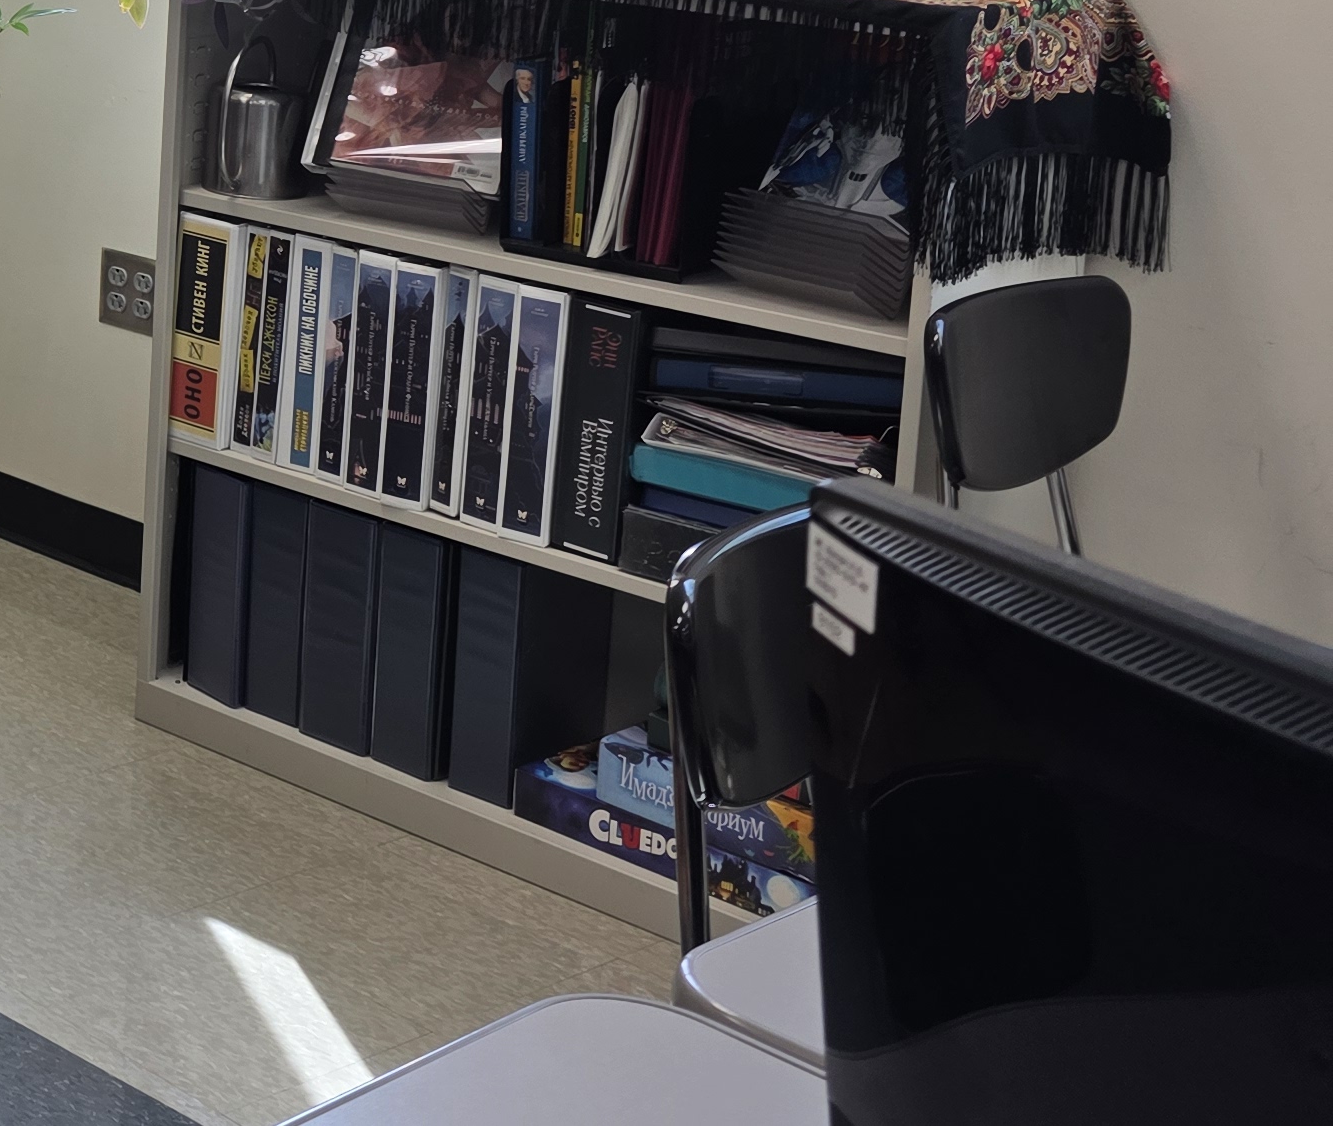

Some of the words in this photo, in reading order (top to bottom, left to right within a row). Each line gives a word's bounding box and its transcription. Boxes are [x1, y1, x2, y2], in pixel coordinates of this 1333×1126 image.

[196, 240, 211, 276] КИНГ
[192, 281, 208, 334] СТИВЕН
[303, 265, 319, 314] ОБОЧИНЕ
[301, 315, 316, 330] НА
[299, 331, 314, 374] ПИКНИК
[184, 368, 203, 420] ОНО
[574, 419, 598, 517] Вампиром
[590, 418, 614, 512] Интервью
